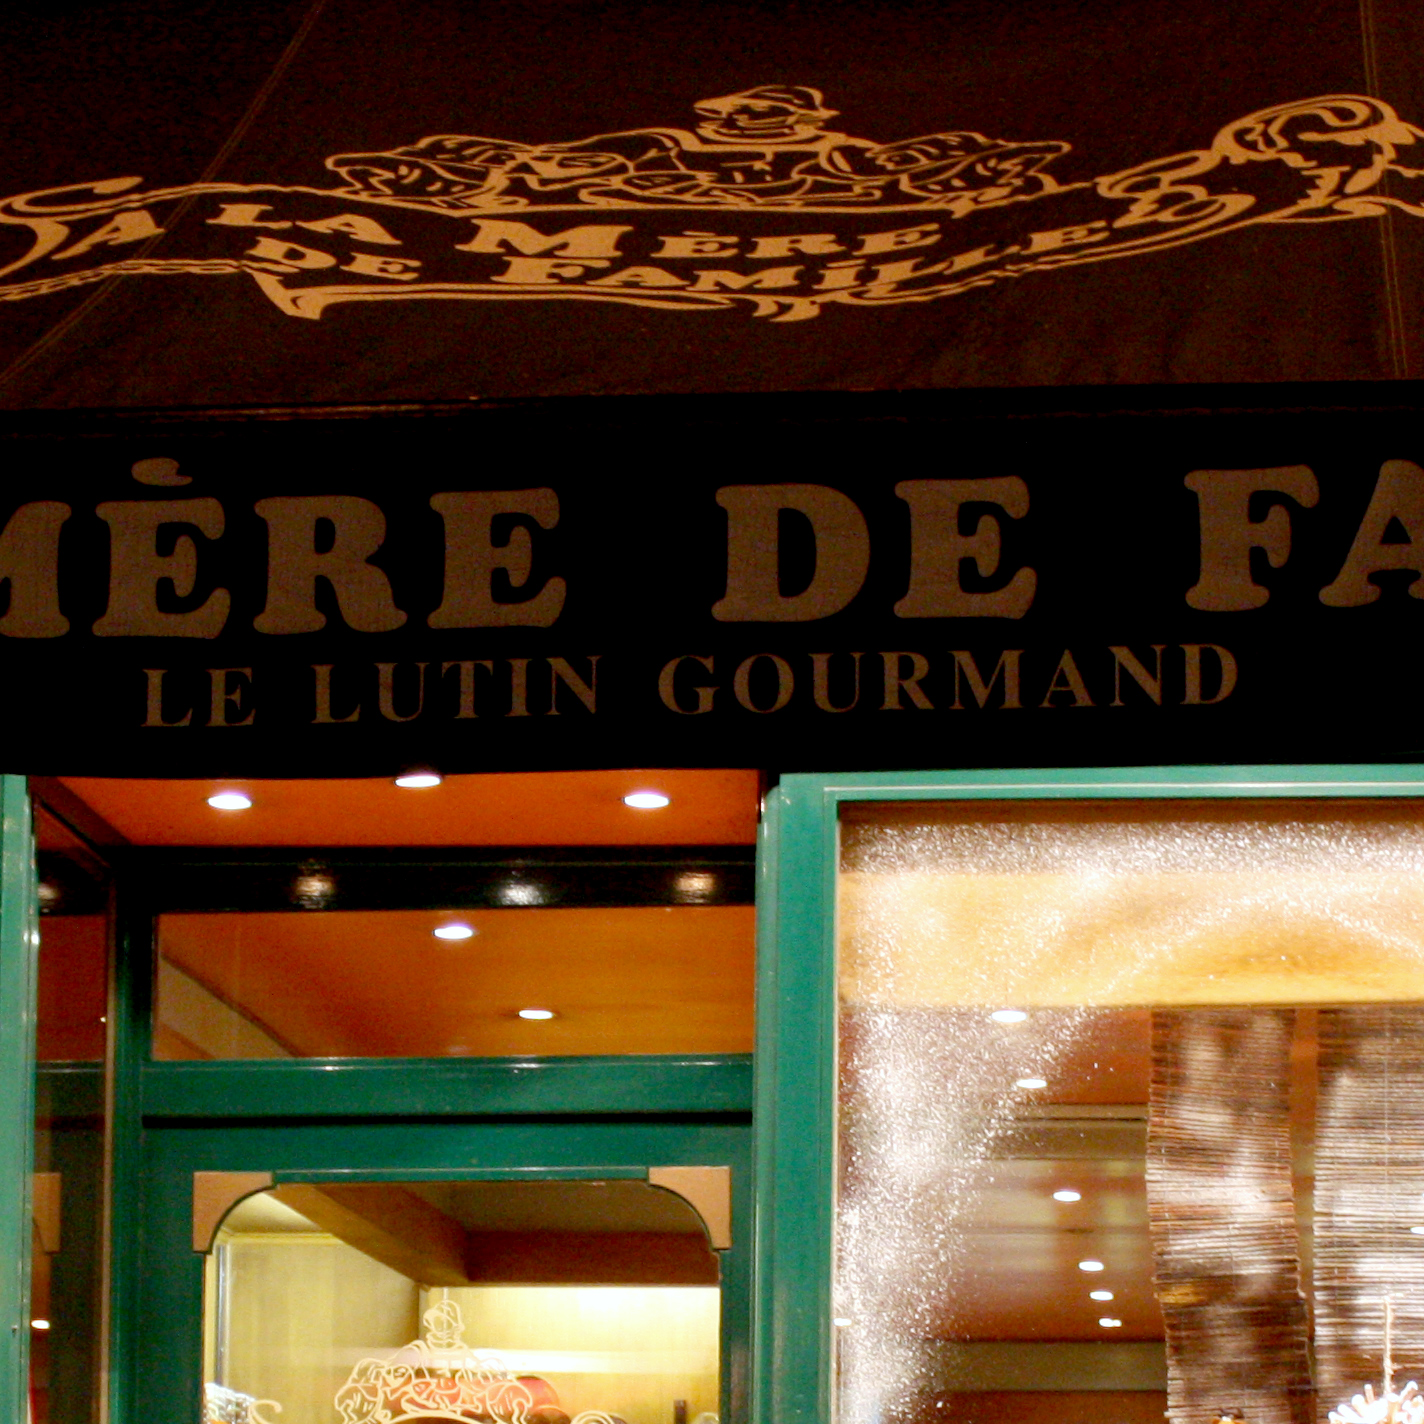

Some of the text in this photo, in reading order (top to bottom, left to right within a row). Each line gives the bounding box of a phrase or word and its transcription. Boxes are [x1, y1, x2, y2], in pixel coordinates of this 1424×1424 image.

[52, 209, 164, 260] A
[206, 203, 402, 244] LA
[243, 236, 422, 279] DE
[711, 475, 1037, 622] DE
[140, 644, 1238, 728] LE LUTIN GOURMAND
